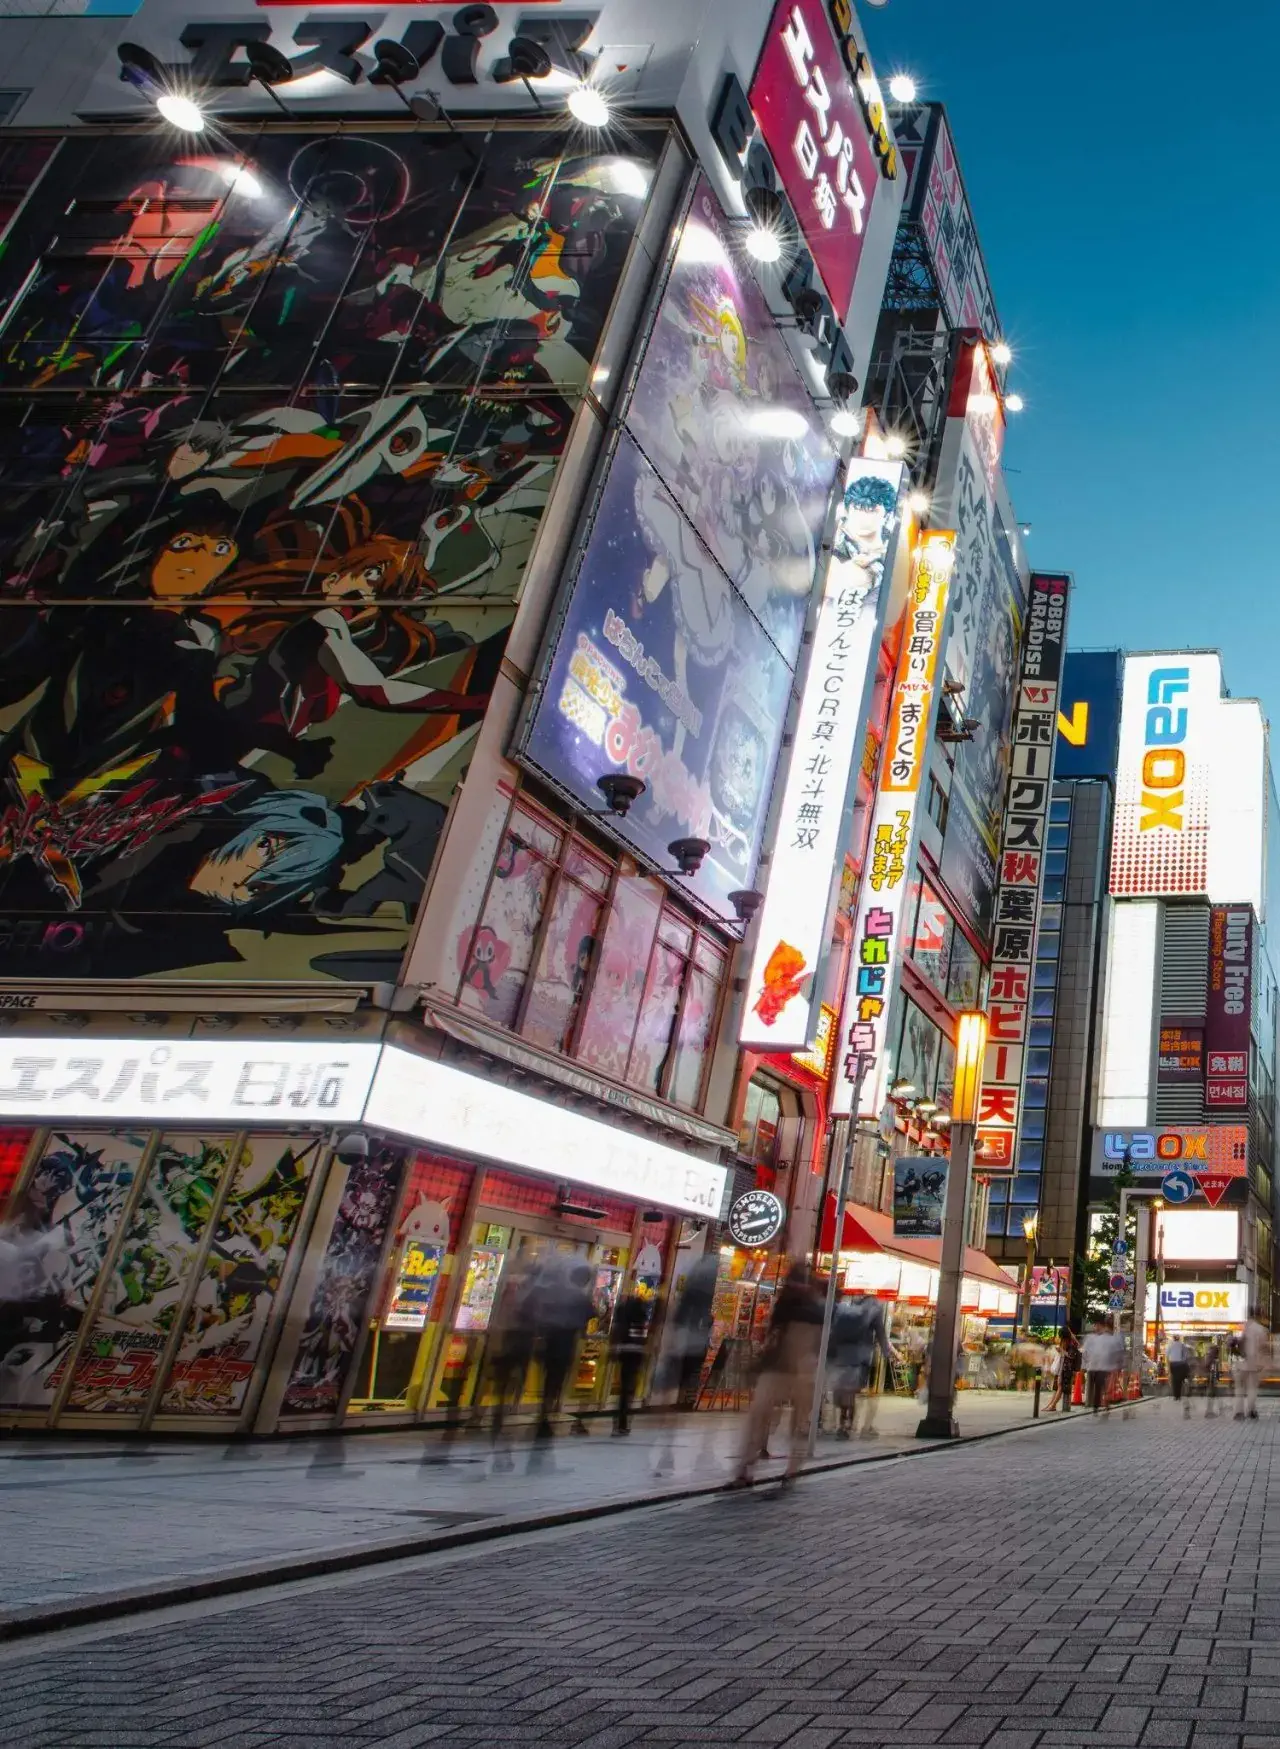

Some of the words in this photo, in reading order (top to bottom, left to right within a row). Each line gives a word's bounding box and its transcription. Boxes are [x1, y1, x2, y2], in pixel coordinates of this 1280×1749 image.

[1023, 577, 1049, 677] PARADISE
[1046, 578, 1066, 646] HOBBY
[1223, 912, 1250, 961] Duty
[1212, 959, 1224, 991] Store
[1223, 965, 1250, 1015] Free
[1211, 1056, 1245, 1072] 免税
[1209, 1085, 1245, 1099] 면세점
[1203, 1179, 1226, 1189] 止まれ
[736, 1193, 778, 1213] SMOKER'S
